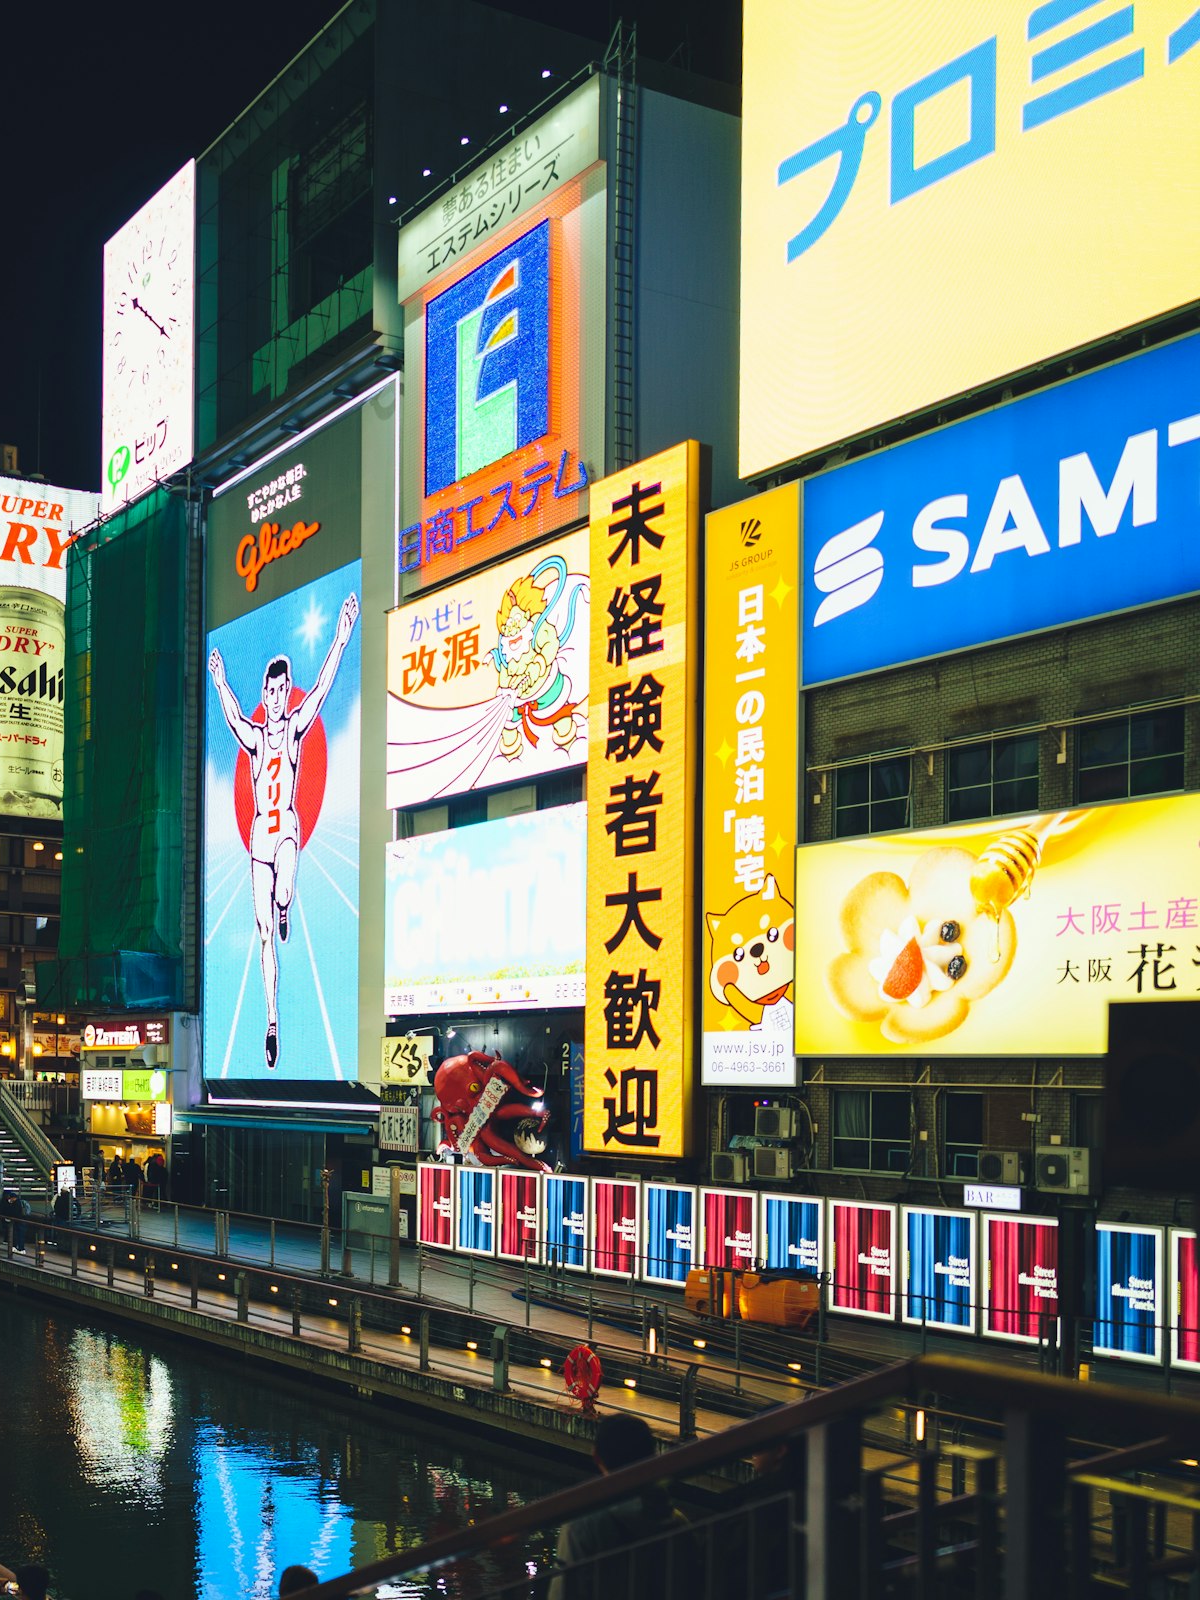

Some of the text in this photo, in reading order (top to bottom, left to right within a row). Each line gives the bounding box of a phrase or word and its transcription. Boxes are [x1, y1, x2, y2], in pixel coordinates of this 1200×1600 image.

[777, 0, 1200, 264] プロミ
[442, 135, 541, 226] 夢ある住まい
[427, 154, 560, 273] エステムシリーズ
[134, 415, 169, 464] ピップ
[251, 484, 302, 524] ゆたかな人生
[399, 449, 588, 575] 日商エステム
[236, 522, 320, 592] Glico
[729, 560, 740, 572] JS
[741, 549, 774, 568] GROUP
[5, 625, 38, 636] SUPER
[408, 599, 474, 643] かぜに
[401, 624, 481, 696] 改源
[9, 703, 32, 720] 生
[266, 750, 283, 835] グリコ
[603, 481, 666, 1148] 未経験者大歓迎
[1056, 942, 1200, 994] 大阪 花
[711, 1061, 786, 1074] 06-4963-3661
[713, 1041, 784, 1057] www.jsv.jp
[966, 1190, 994, 1203] BAR
[871, 1246, 889, 1258] Street
[948, 1255, 968, 1267] Street
[1034, 1265, 1055, 1278] Street
[1129, 1275, 1152, 1290] Street
